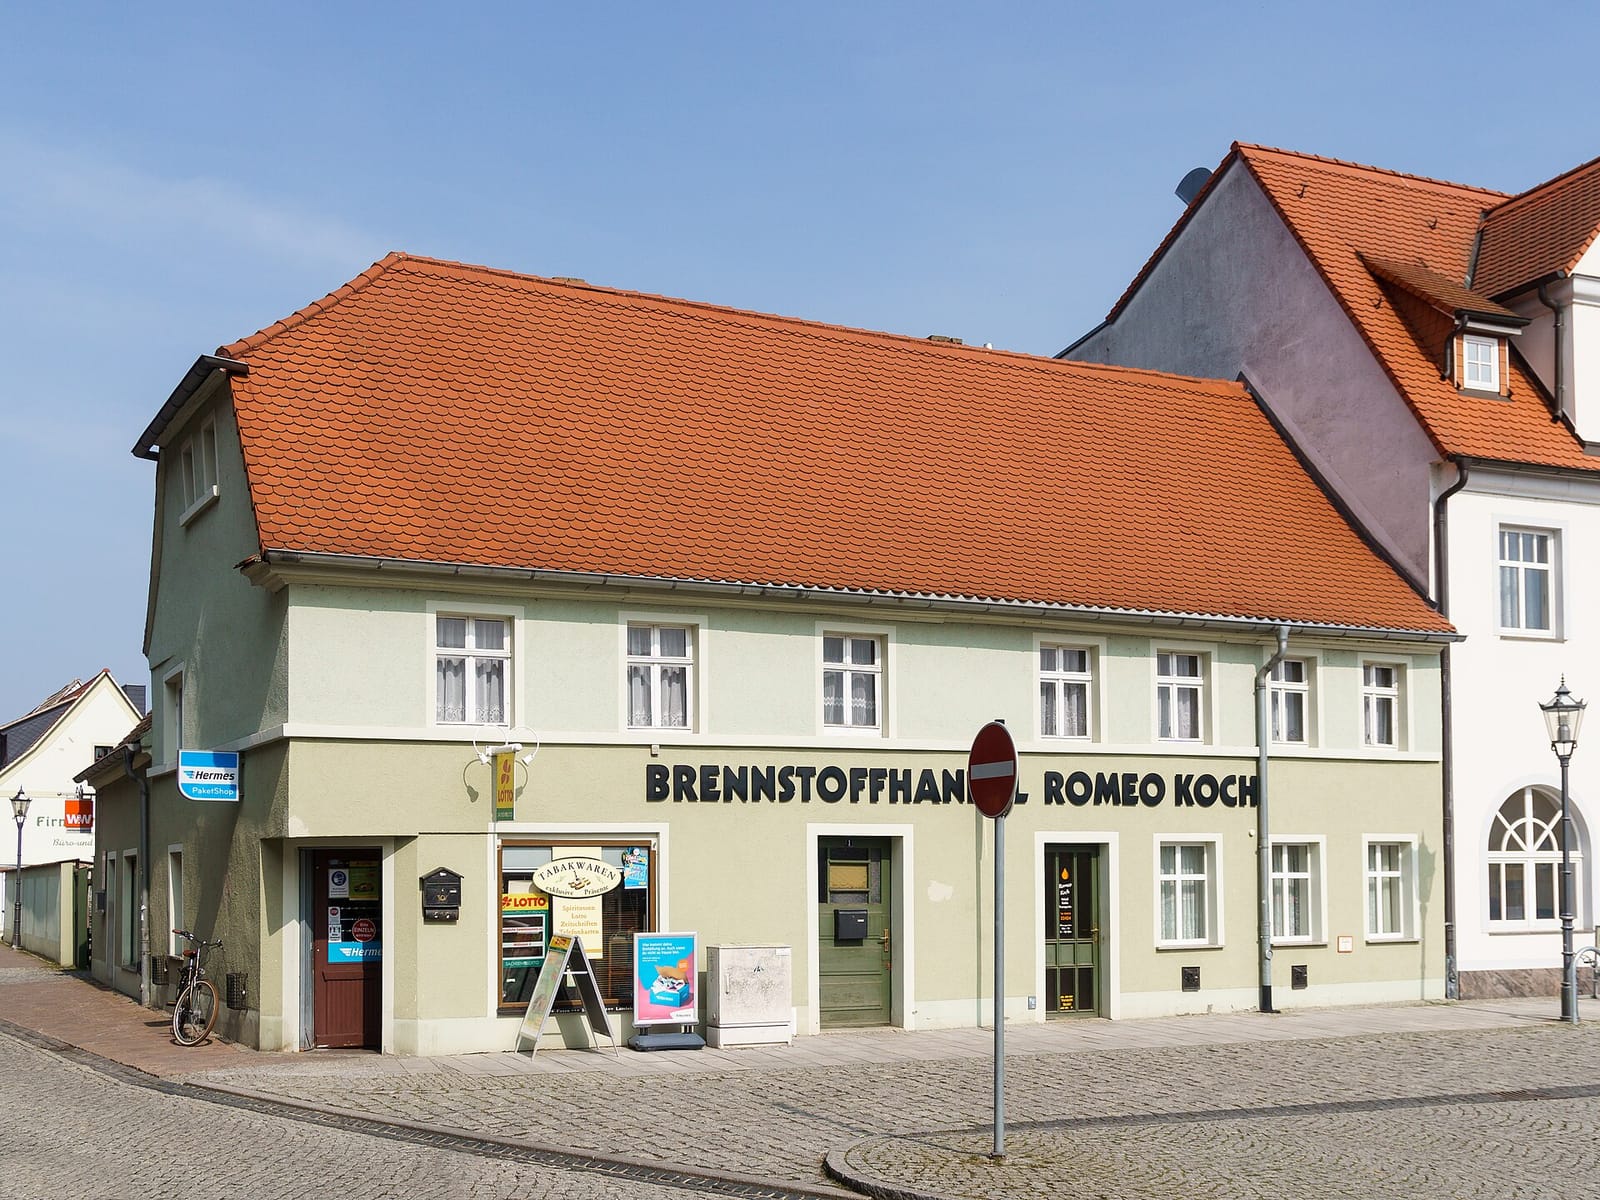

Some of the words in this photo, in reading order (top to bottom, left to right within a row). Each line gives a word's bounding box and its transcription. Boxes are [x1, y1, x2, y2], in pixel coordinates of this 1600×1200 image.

[195, 770, 235, 781] Hermes
[192, 786, 234, 796] PaketShop
[1044, 771, 1166, 807] ROMEO
[1174, 773, 1259, 807] KOCH
[498, 790, 514, 803] LOTTO
[538, 861, 616, 881] TABAKWAREN
[513, 897, 546, 907] LOTTO
